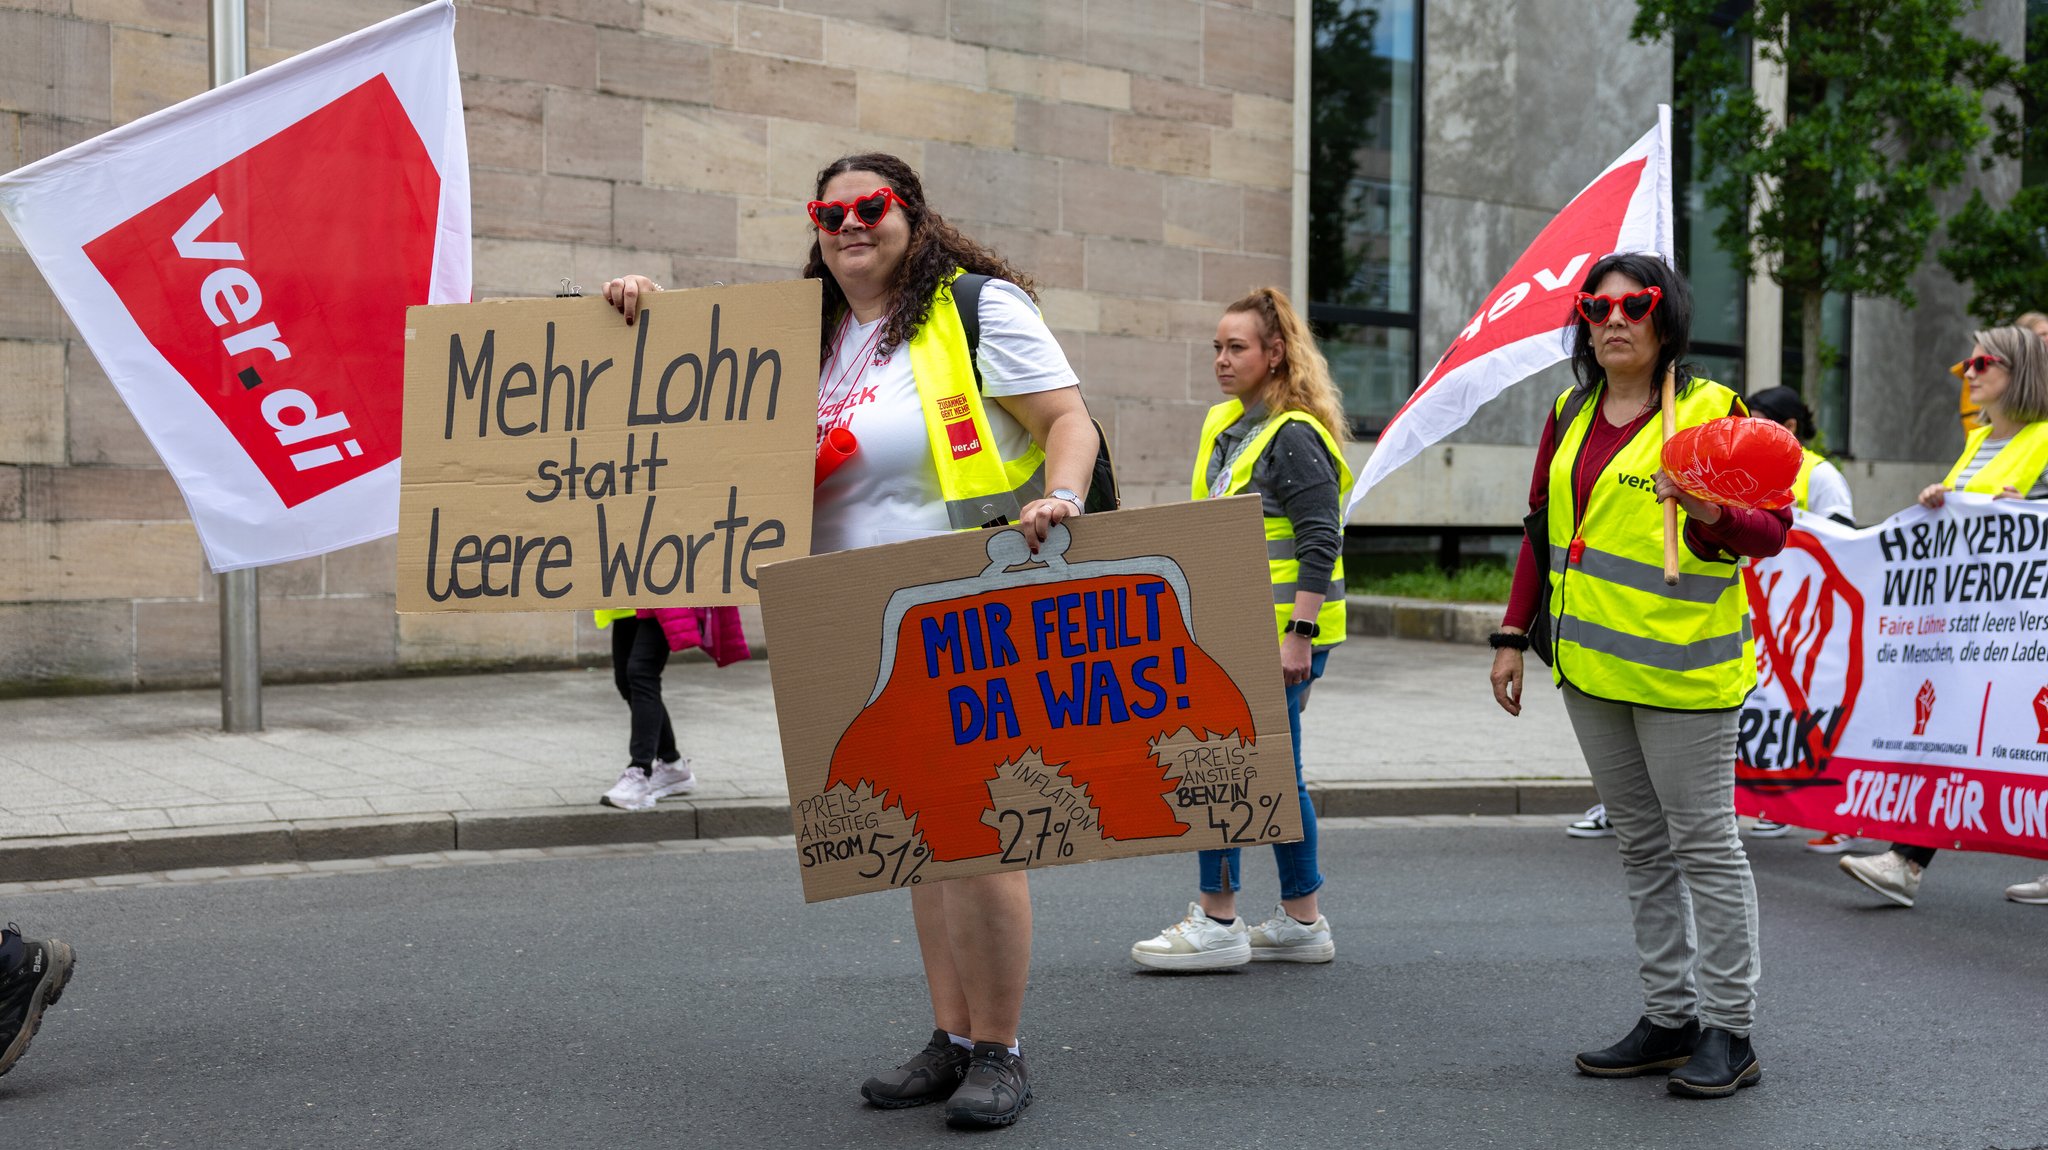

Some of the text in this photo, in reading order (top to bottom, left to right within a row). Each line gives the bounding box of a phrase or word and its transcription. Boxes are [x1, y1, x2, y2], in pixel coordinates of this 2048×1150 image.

[171, 193, 364, 472] ver.di
[444, 303, 782, 440] Mehr Lohn
[937, 395, 968, 410] ZUSAMMEN
[940, 403, 971, 419] GEHT MEHR
[525, 431, 669, 503] statt
[951, 439, 980, 453] ver.di
[1618, 472, 1658, 494] ver.
[596, 485, 786, 599] Worte
[1879, 518, 1957, 562] H&M
[1883, 566, 1938, 607] WIR
[920, 581, 1166, 679] MIR FEHLT
[1879, 610, 2048, 636] Faire Löhne statt leere Vers
[1877, 641, 1898, 664] die
[1960, 639, 1981, 662] die
[1983, 640, 2009, 662] den
[948, 646, 1191, 746] DA WAS!
[1178, 746, 1258, 770] PREIS-
[1737, 705, 1847, 772] REIK!
[1991, 744, 2048, 763] FÜR GERECHT
[1012, 762, 1097, 832] INFLATION
[1176, 779, 1250, 808] BENZIN
[1182, 766, 1258, 787] ANSTIEG
[797, 793, 871, 822] PREIS-
[1208, 793, 1283, 844] 42%
[1834, 768, 1927, 825] STREIK
[1928, 771, 1989, 834] FÜR
[800, 812, 880, 842] ANSTIEG
[999, 807, 1074, 866] 2,7%
[802, 832, 931, 887] STROM 51%
